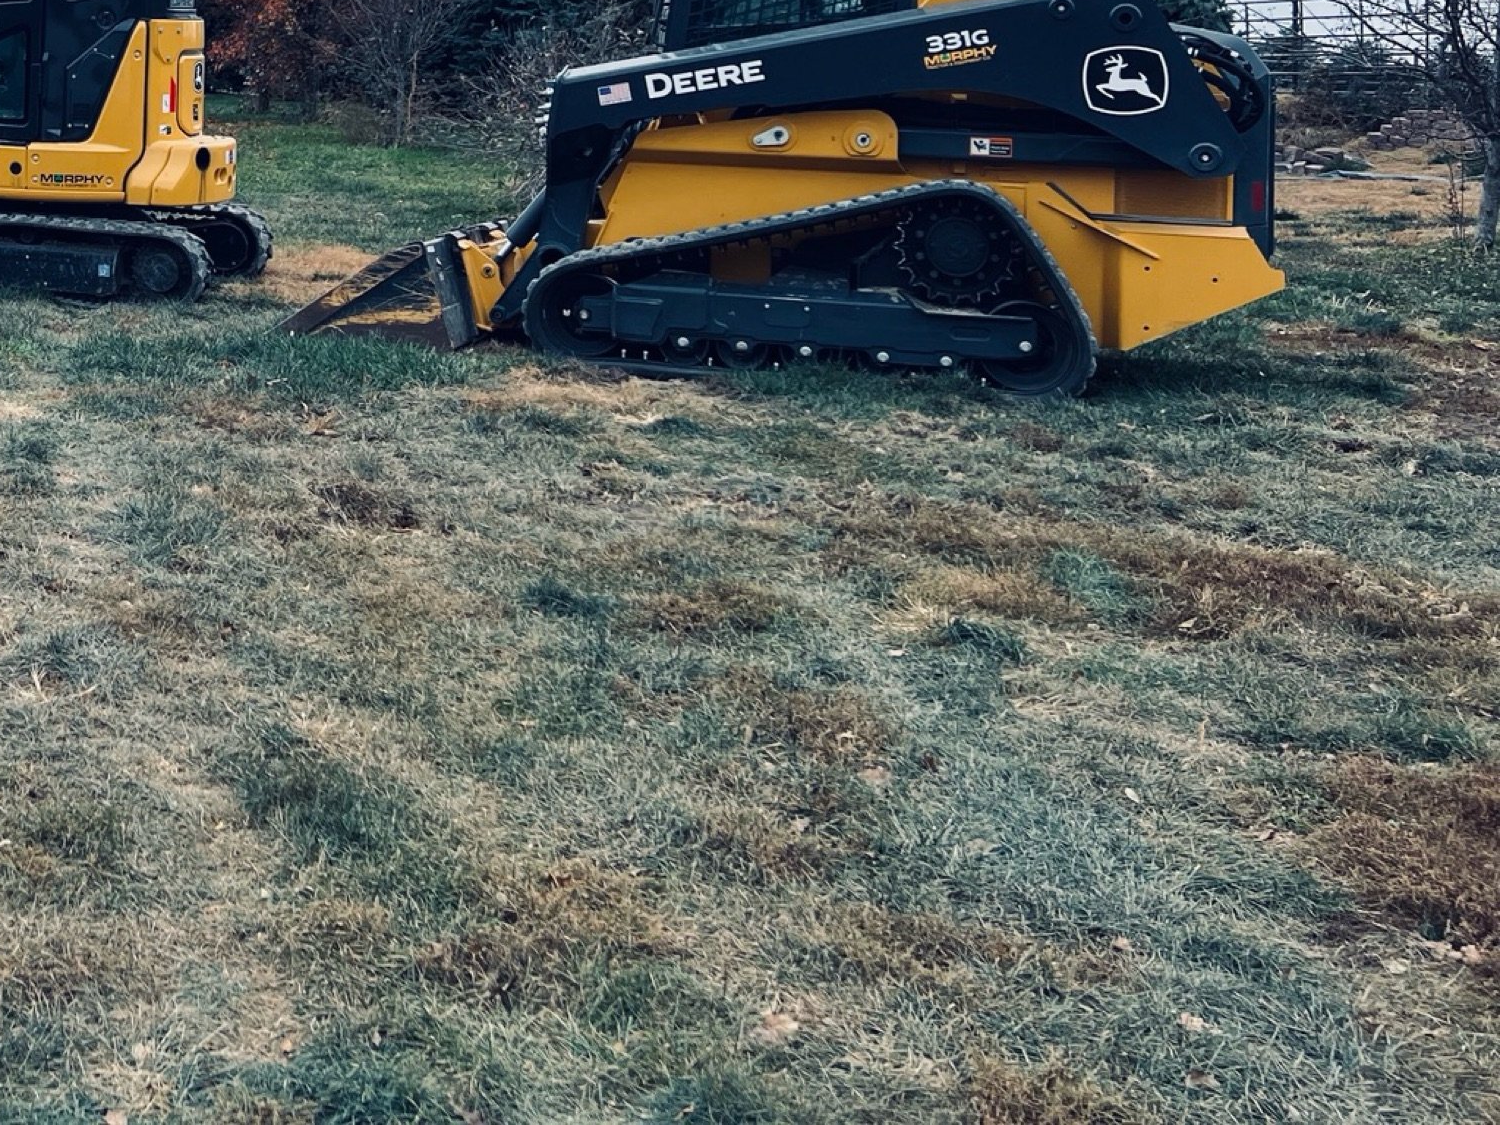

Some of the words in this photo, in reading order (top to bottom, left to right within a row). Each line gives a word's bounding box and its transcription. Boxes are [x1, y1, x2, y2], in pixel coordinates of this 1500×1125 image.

[925, 28, 990, 54] 331G
[923, 44, 997, 67] MURPHY
[644, 59, 766, 99] DEERE
[40, 173, 104, 184] MURPHY
